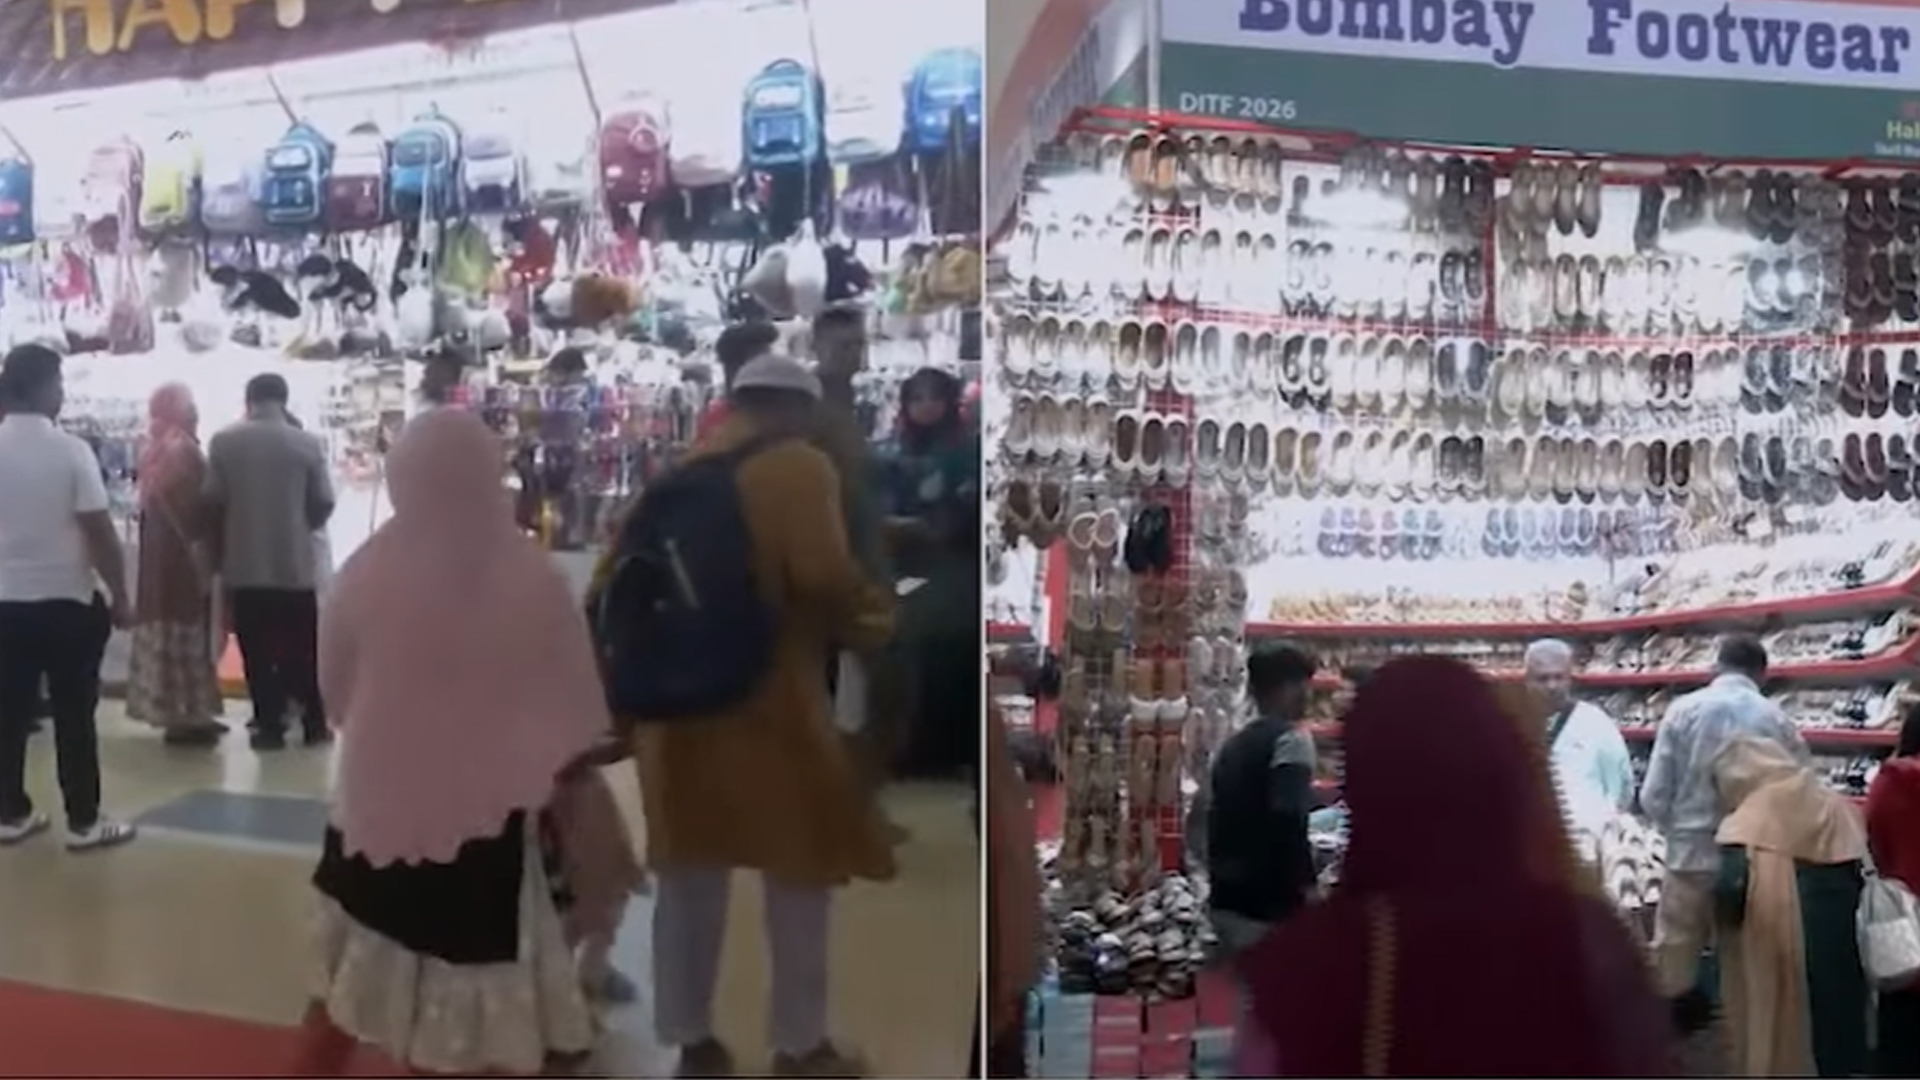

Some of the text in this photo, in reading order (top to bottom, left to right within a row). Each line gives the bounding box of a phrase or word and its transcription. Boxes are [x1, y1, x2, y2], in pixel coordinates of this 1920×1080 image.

[1587, 0, 1911, 73] Footwear
[1180, 92, 1297, 119] DITF 2026
